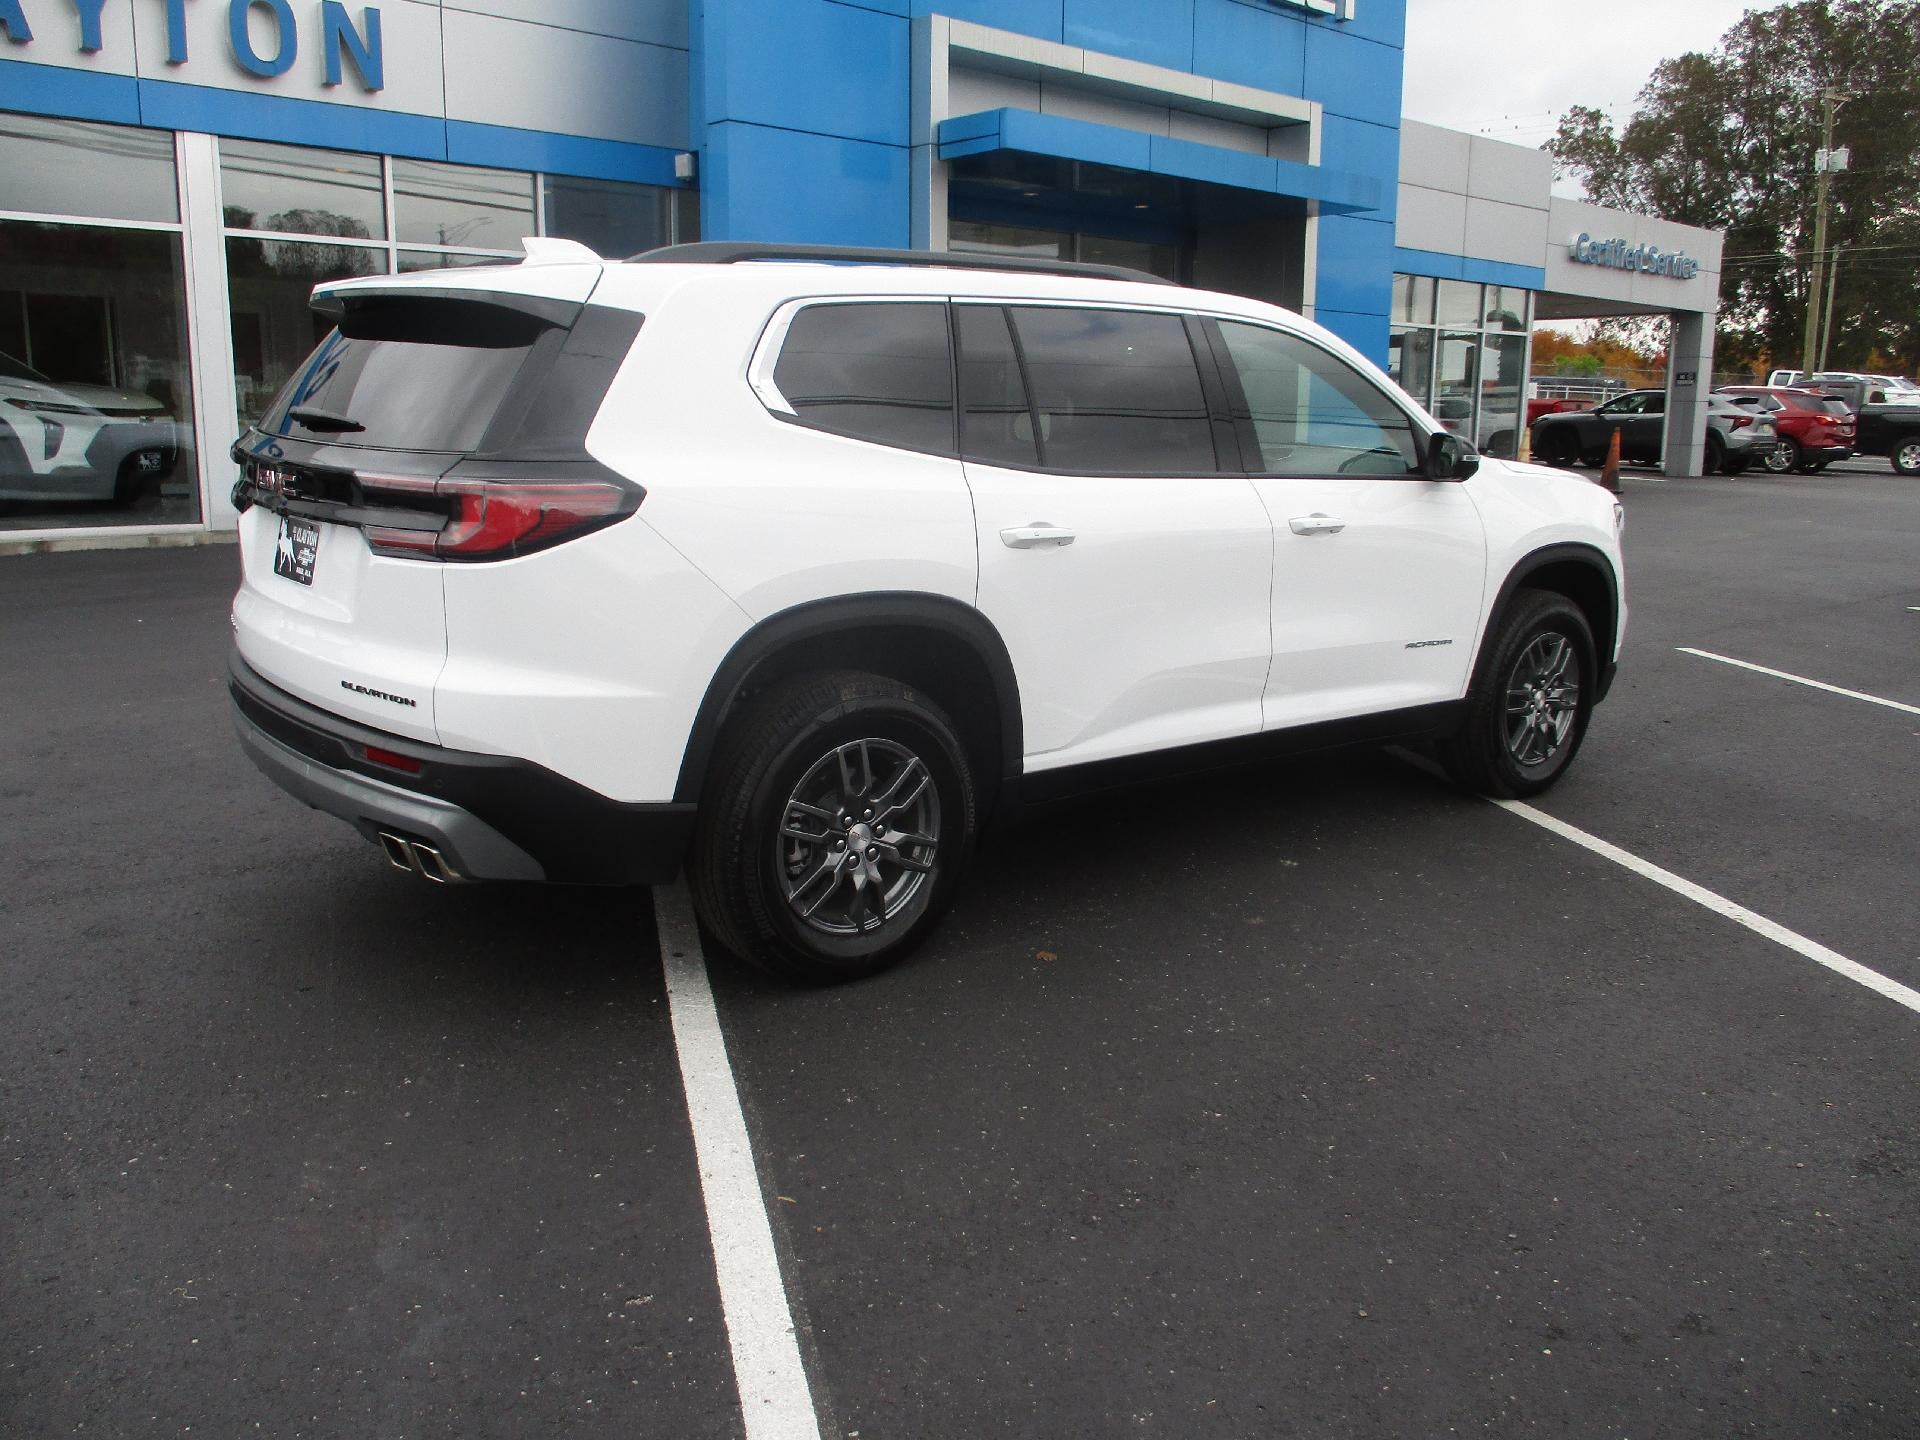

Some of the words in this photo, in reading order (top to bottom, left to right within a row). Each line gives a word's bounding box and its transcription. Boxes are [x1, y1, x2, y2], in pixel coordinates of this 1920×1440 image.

[1575, 232, 1645, 271] Certified
[1647, 245, 1699, 279] Service
[341, 680, 416, 707] ELEVATION
